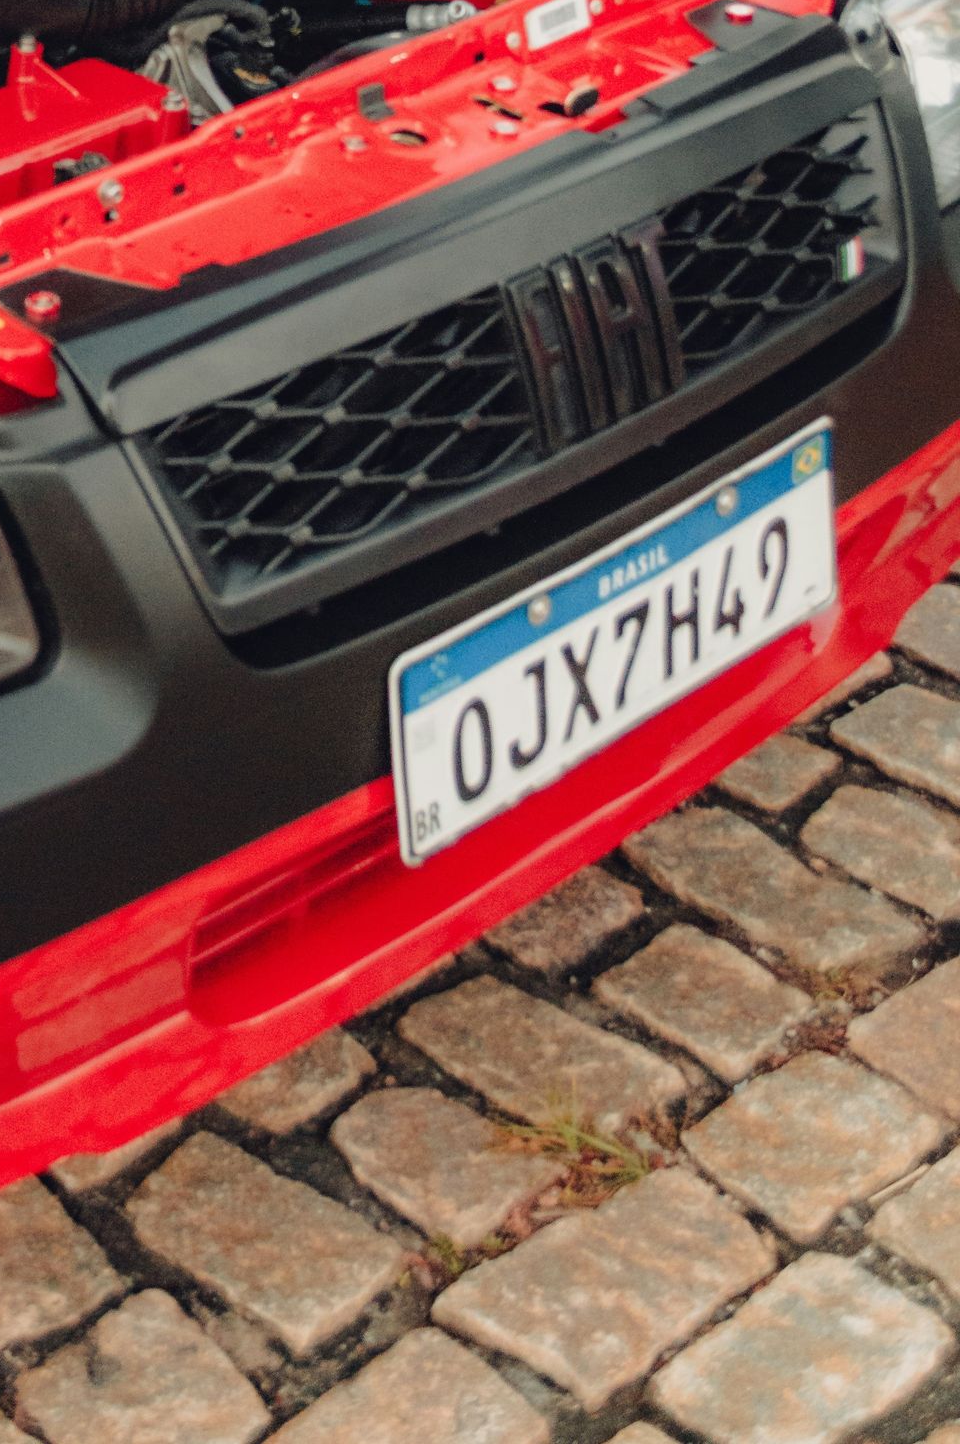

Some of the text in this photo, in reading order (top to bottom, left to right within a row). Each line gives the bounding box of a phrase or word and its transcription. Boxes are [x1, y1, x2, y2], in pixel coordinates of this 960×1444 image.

[502, 219, 688, 448] FIAT
[598, 544, 669, 598] BRASIL
[453, 517, 789, 803] OJX7H49
[415, 801, 441, 841] BR
